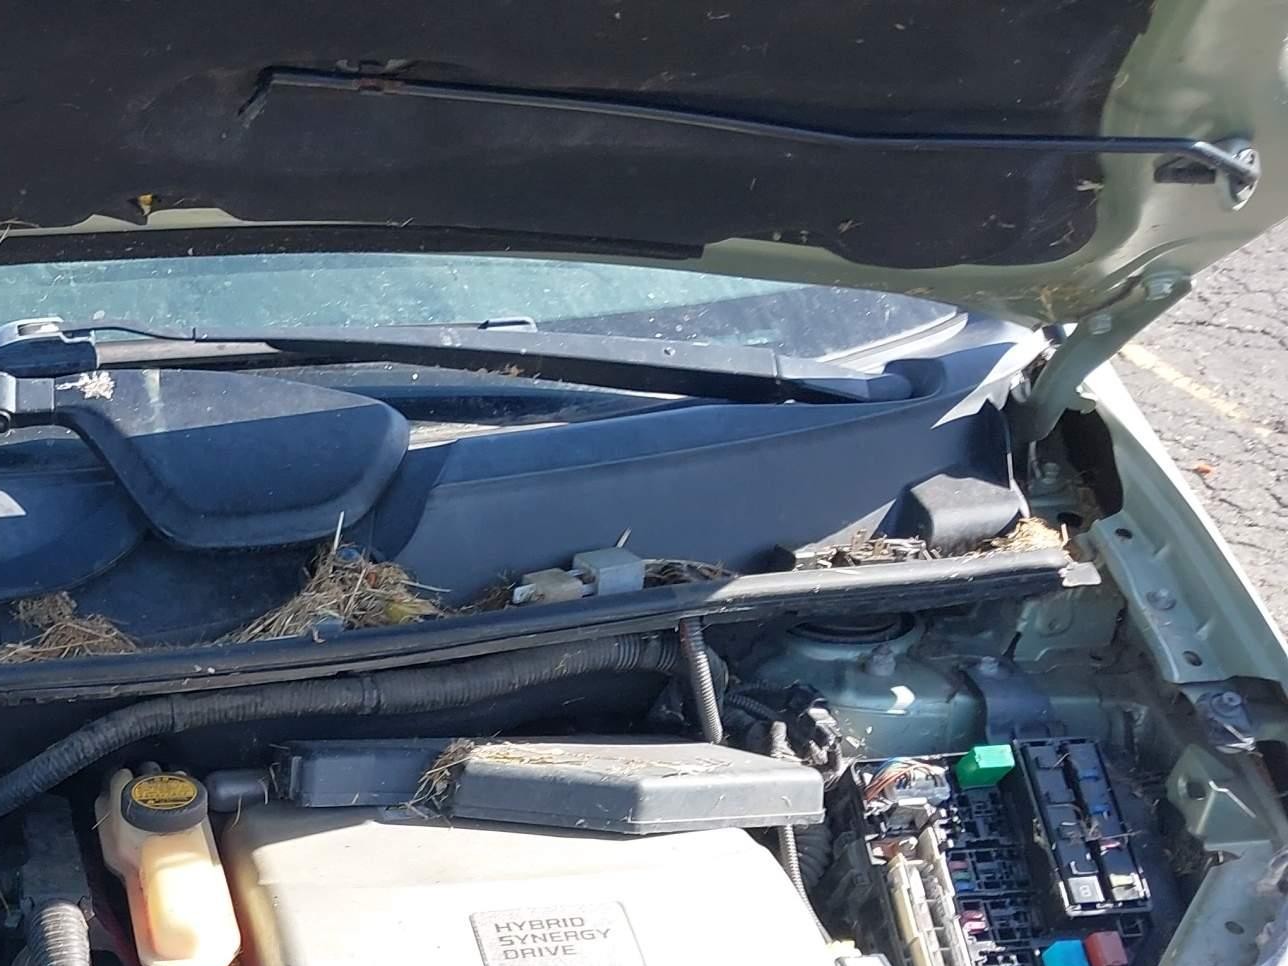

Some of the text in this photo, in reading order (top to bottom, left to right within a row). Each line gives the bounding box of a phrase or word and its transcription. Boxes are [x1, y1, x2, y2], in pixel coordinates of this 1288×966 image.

[494, 916, 585, 933] HYBRID
[497, 928, 611, 946] SYNERGY
[503, 944, 577, 960] DRIVE
